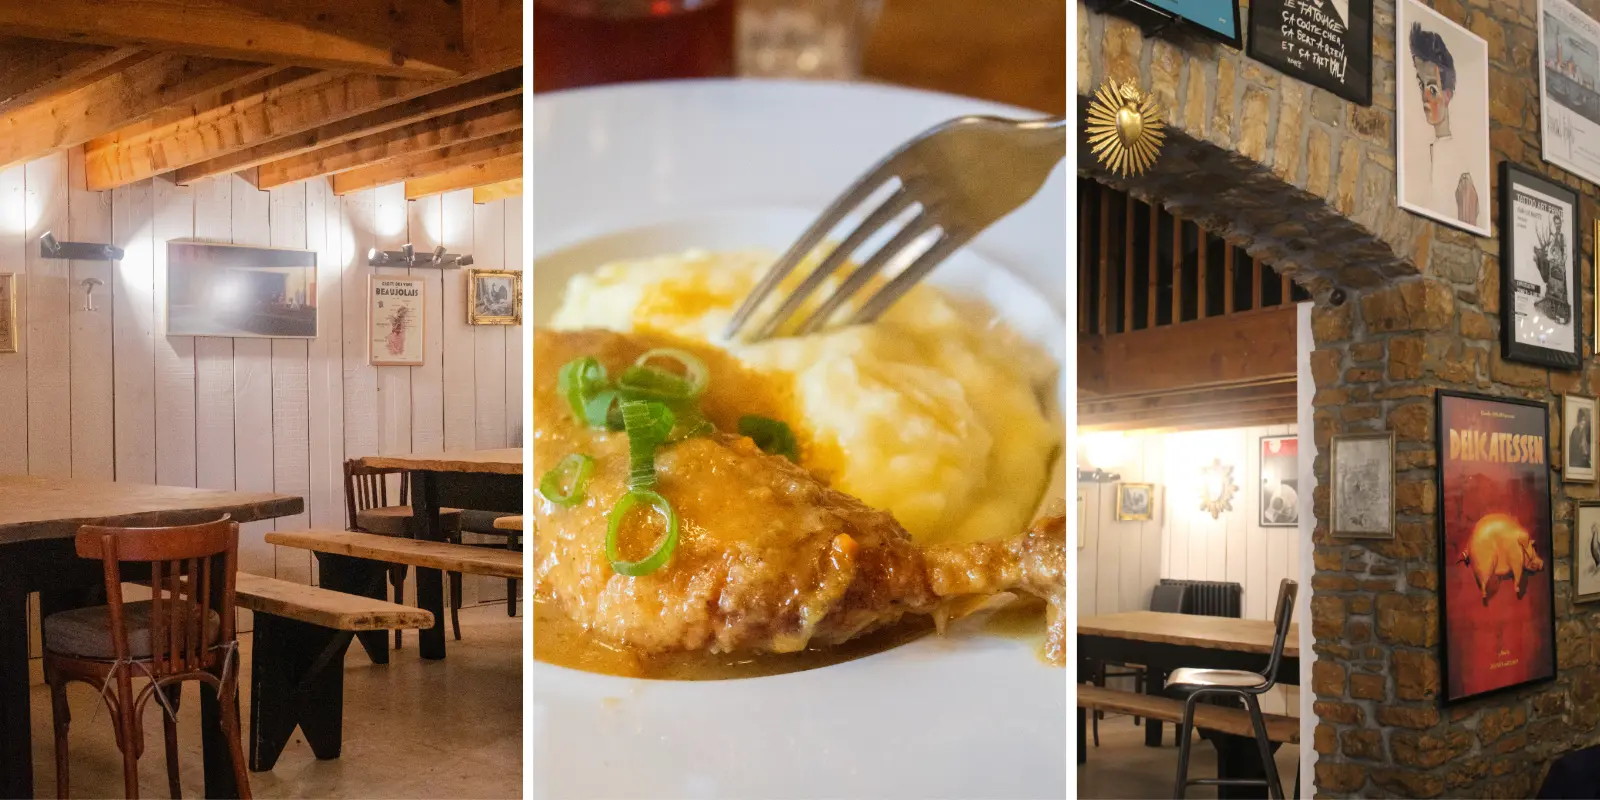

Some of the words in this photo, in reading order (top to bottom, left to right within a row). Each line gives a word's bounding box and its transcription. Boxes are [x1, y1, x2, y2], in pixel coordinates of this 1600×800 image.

[1297, 1, 1343, 33] TATOUAGE
[1281, 41, 1294, 51] ET
[1312, 53, 1329, 69] FAIT
[1325, 44, 1344, 60] RIEN
[376, 287, 419, 297] BEAUJOLAIS
[1449, 428, 1544, 465] DELICATESSEN
